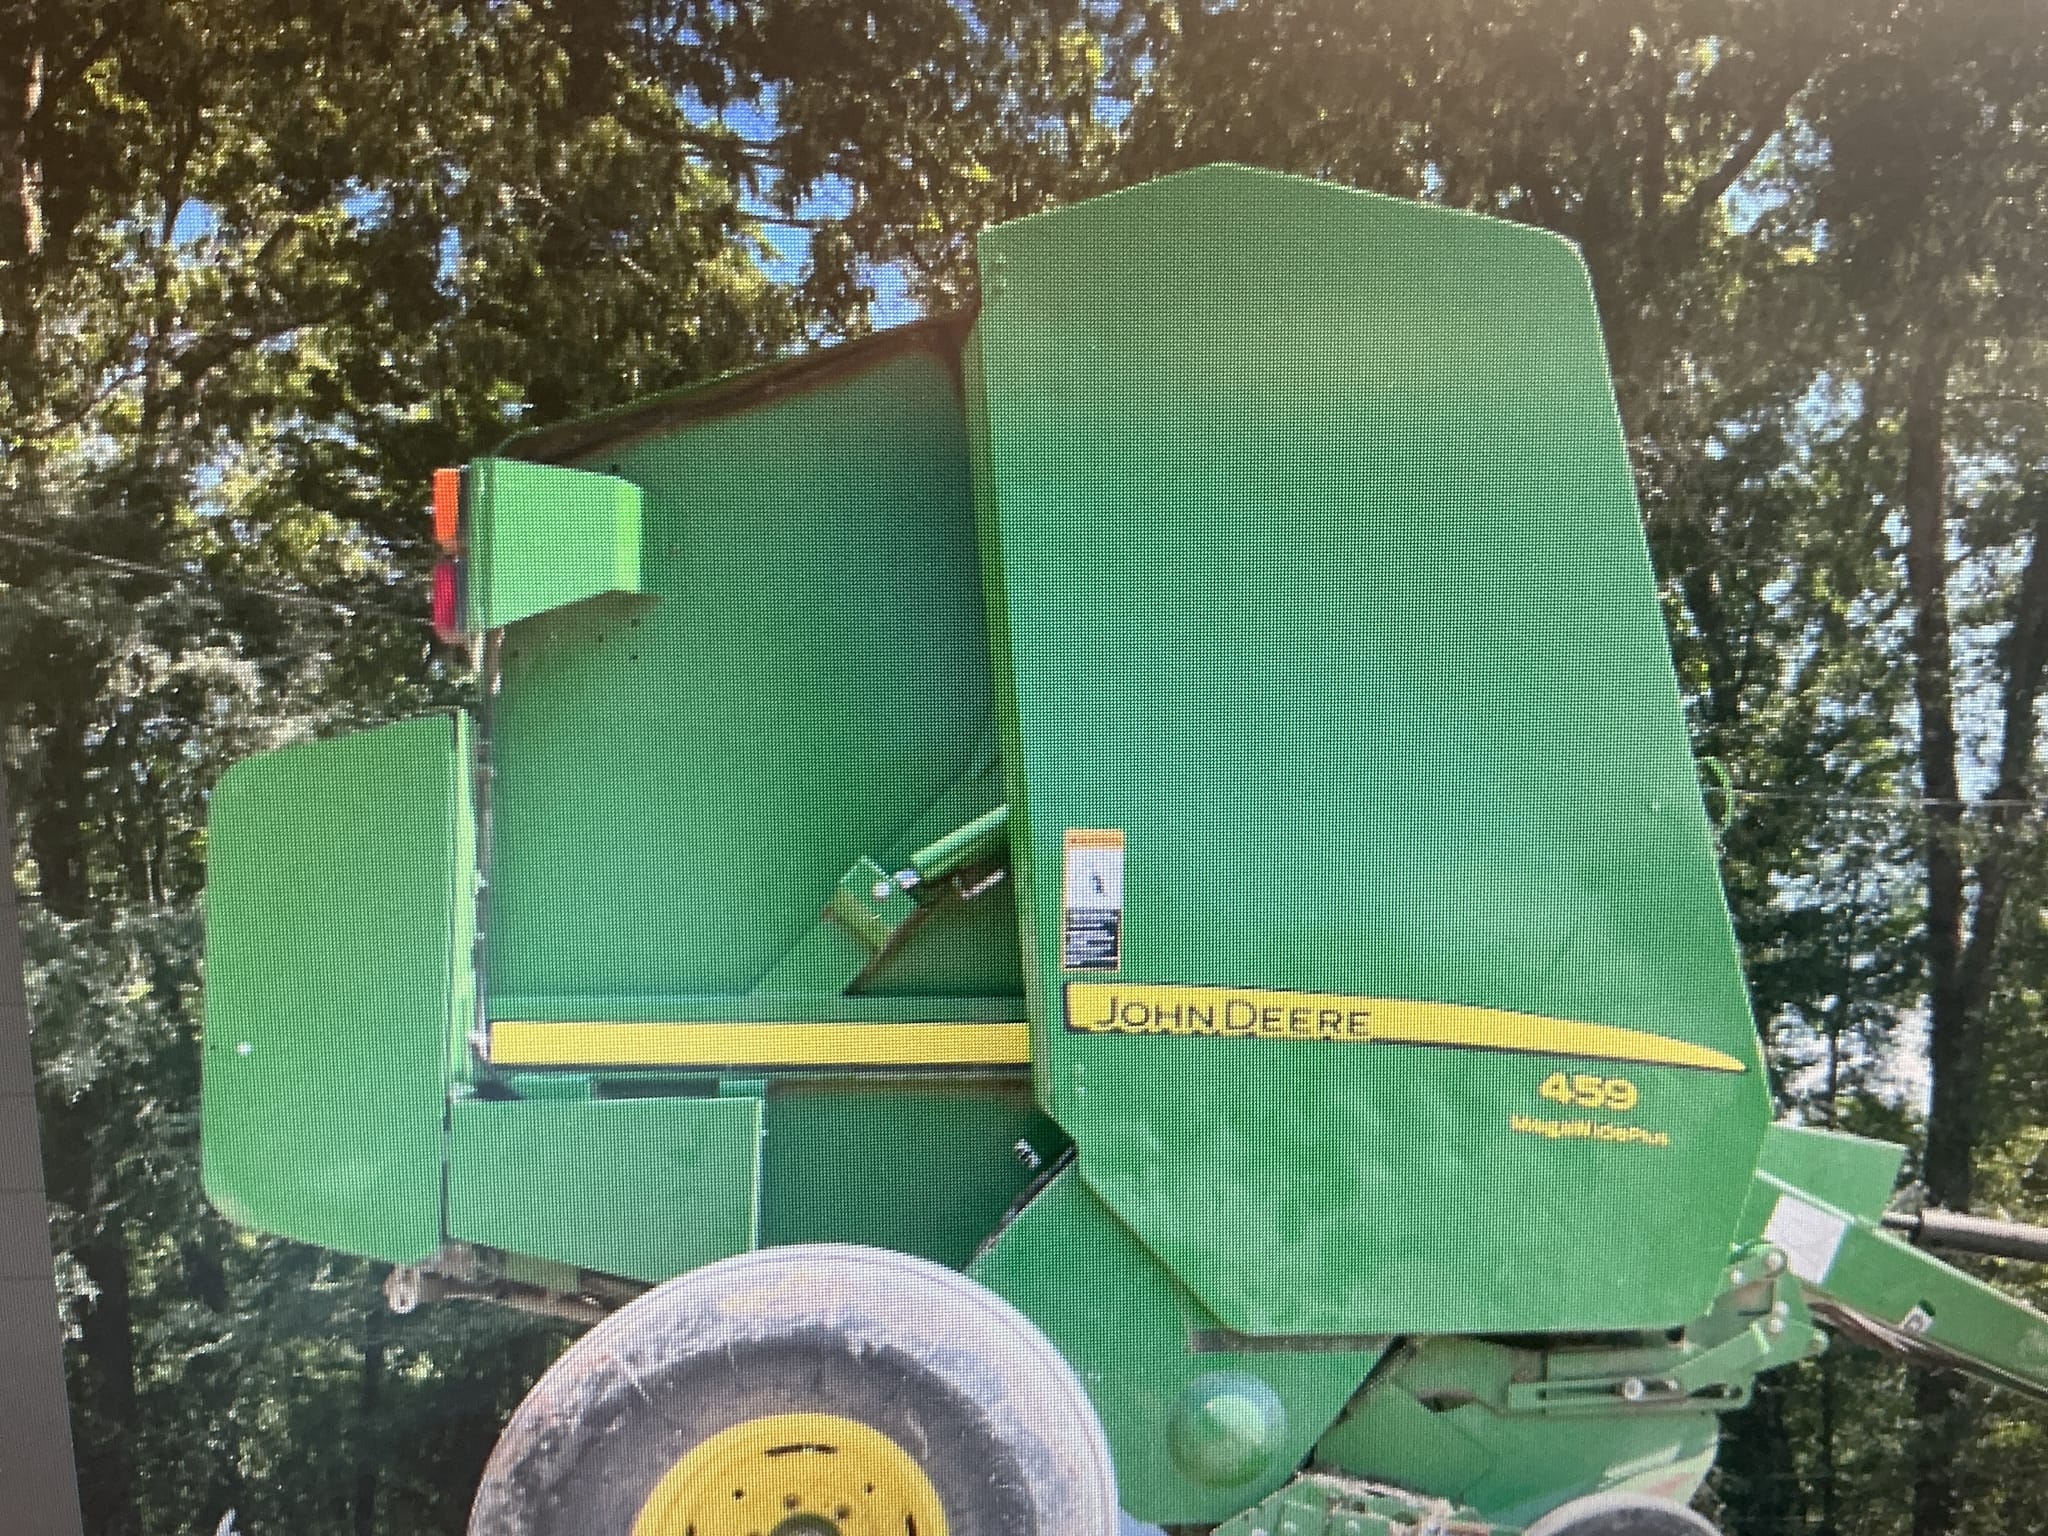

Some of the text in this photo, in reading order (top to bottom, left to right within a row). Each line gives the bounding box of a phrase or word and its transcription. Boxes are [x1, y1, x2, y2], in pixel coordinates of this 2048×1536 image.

[1096, 996, 1372, 1036] JOHN DEERE
[1539, 1072, 1640, 1111] 459
